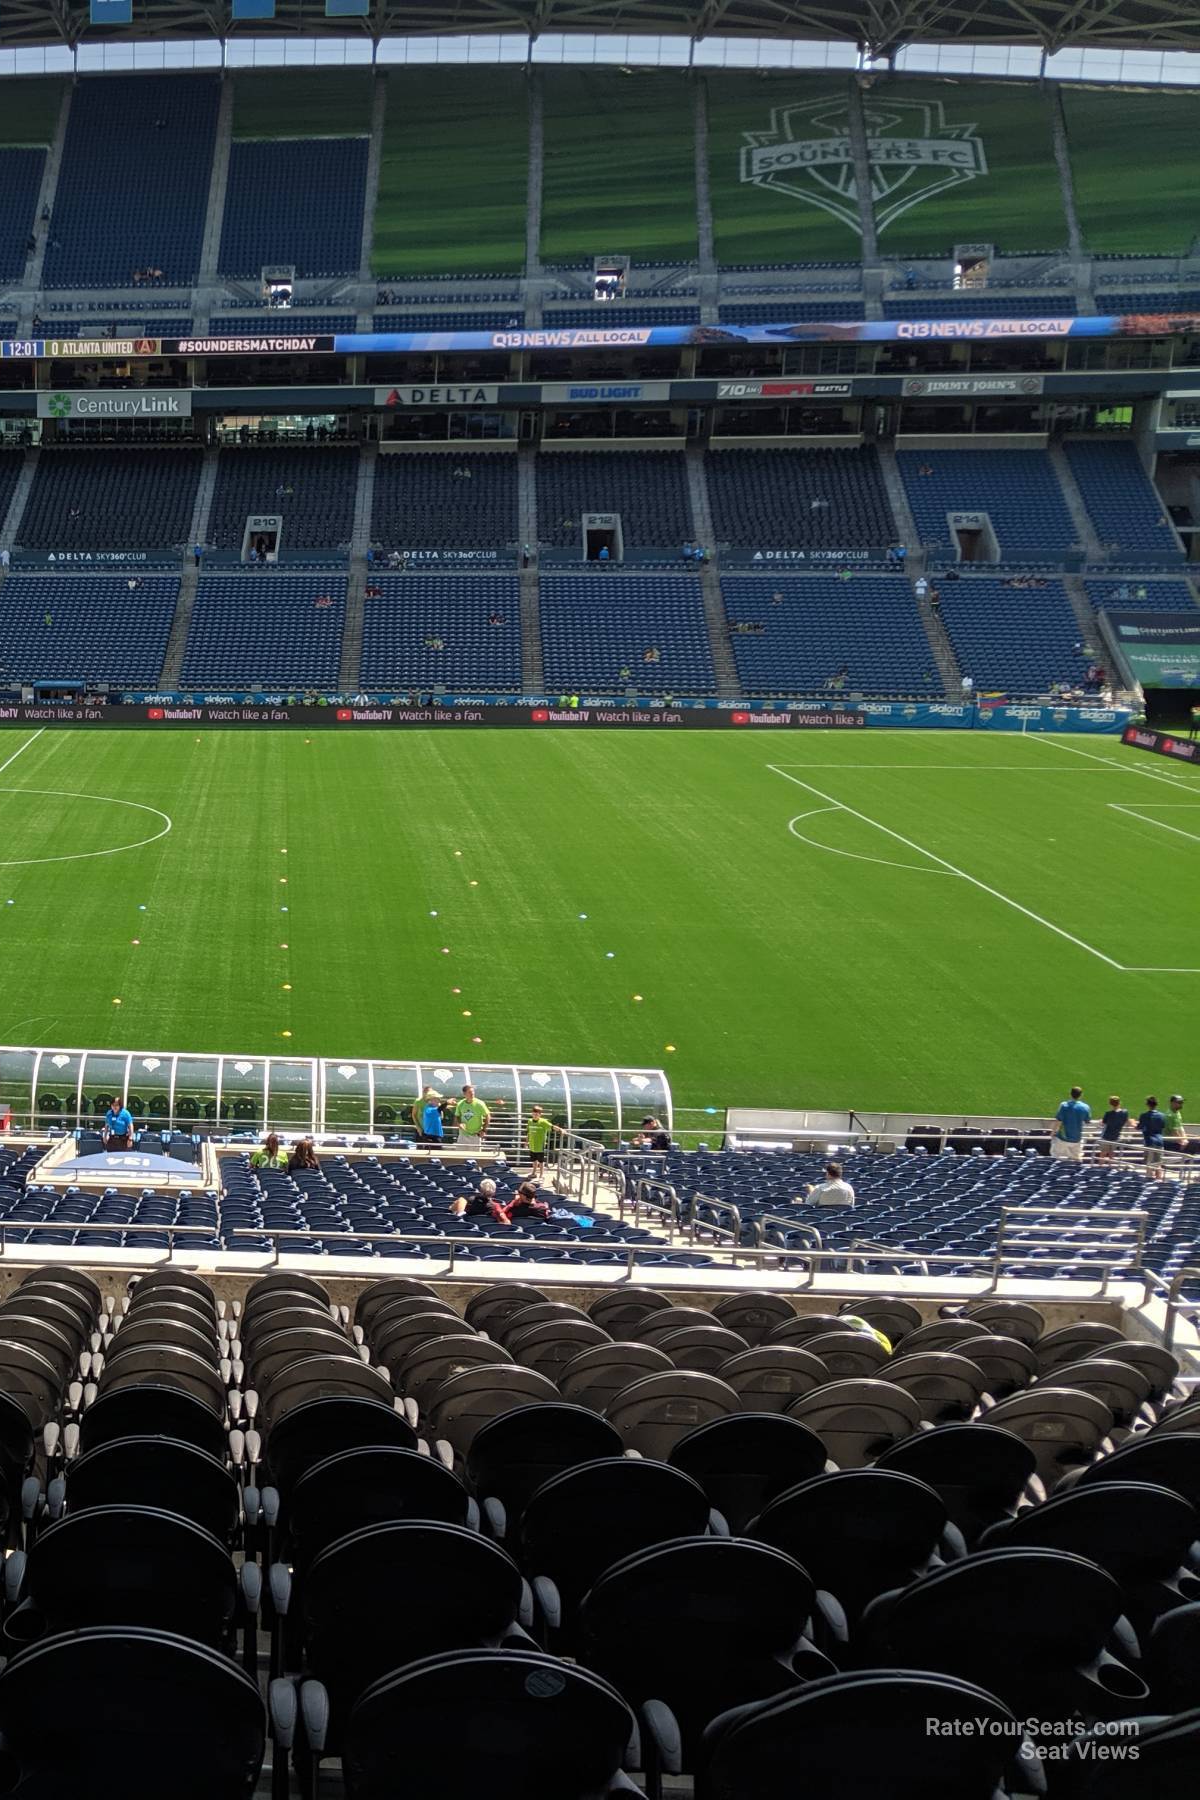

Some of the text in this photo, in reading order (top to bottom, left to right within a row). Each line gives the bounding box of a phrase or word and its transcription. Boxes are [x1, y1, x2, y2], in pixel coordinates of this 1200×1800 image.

[932, 151, 969, 163] FC
[931, 322, 985, 337] NEWS
[990, 323, 1014, 334] ALL
[1019, 321, 1065, 333] LOCAL
[522, 332, 571, 346] NEWS
[576, 332, 600, 343] ALL
[602, 331, 644, 343] LOCAL
[9, 342, 37, 356] 12:01
[62, 342, 101, 355] ATLANTA
[102, 341, 133, 354] UNITED
[179, 338, 317, 352] #SOUNDERSMATCHDAY
[720, 385, 746, 396] 710
[927, 380, 1017, 393] JIMMY JOHN'S
[411, 388, 486, 404] DELTA
[570, 386, 642, 400] BUD LIGHT
[76, 398, 179, 416] CenturyLink
[253, 518, 277, 526] 210
[588, 516, 613, 524] 212
[403, 551, 439, 559] DELTA
[766, 551, 805, 559] DELTA
[25, 708, 55, 719] Watch
[58, 708, 73, 719] like
[85, 708, 103, 719] fan.
[857, 703, 892, 713] slalom
[928, 704, 964, 714] slalom
[1004, 706, 1041, 718] slalom
[209, 709, 239, 720] Watch
[243, 709, 259, 720] like
[271, 709, 290, 720] fan.
[399, 710, 431, 721] Watch
[434, 710, 451, 721] like
[463, 710, 484, 721] fan.
[597, 711, 629, 722] Watch
[632, 711, 650, 722] like
[663, 711, 684, 722] fan.
[799, 713, 833, 724] Watch
[836, 713, 854, 724] like
[1079, 708, 1116, 720] slalom
